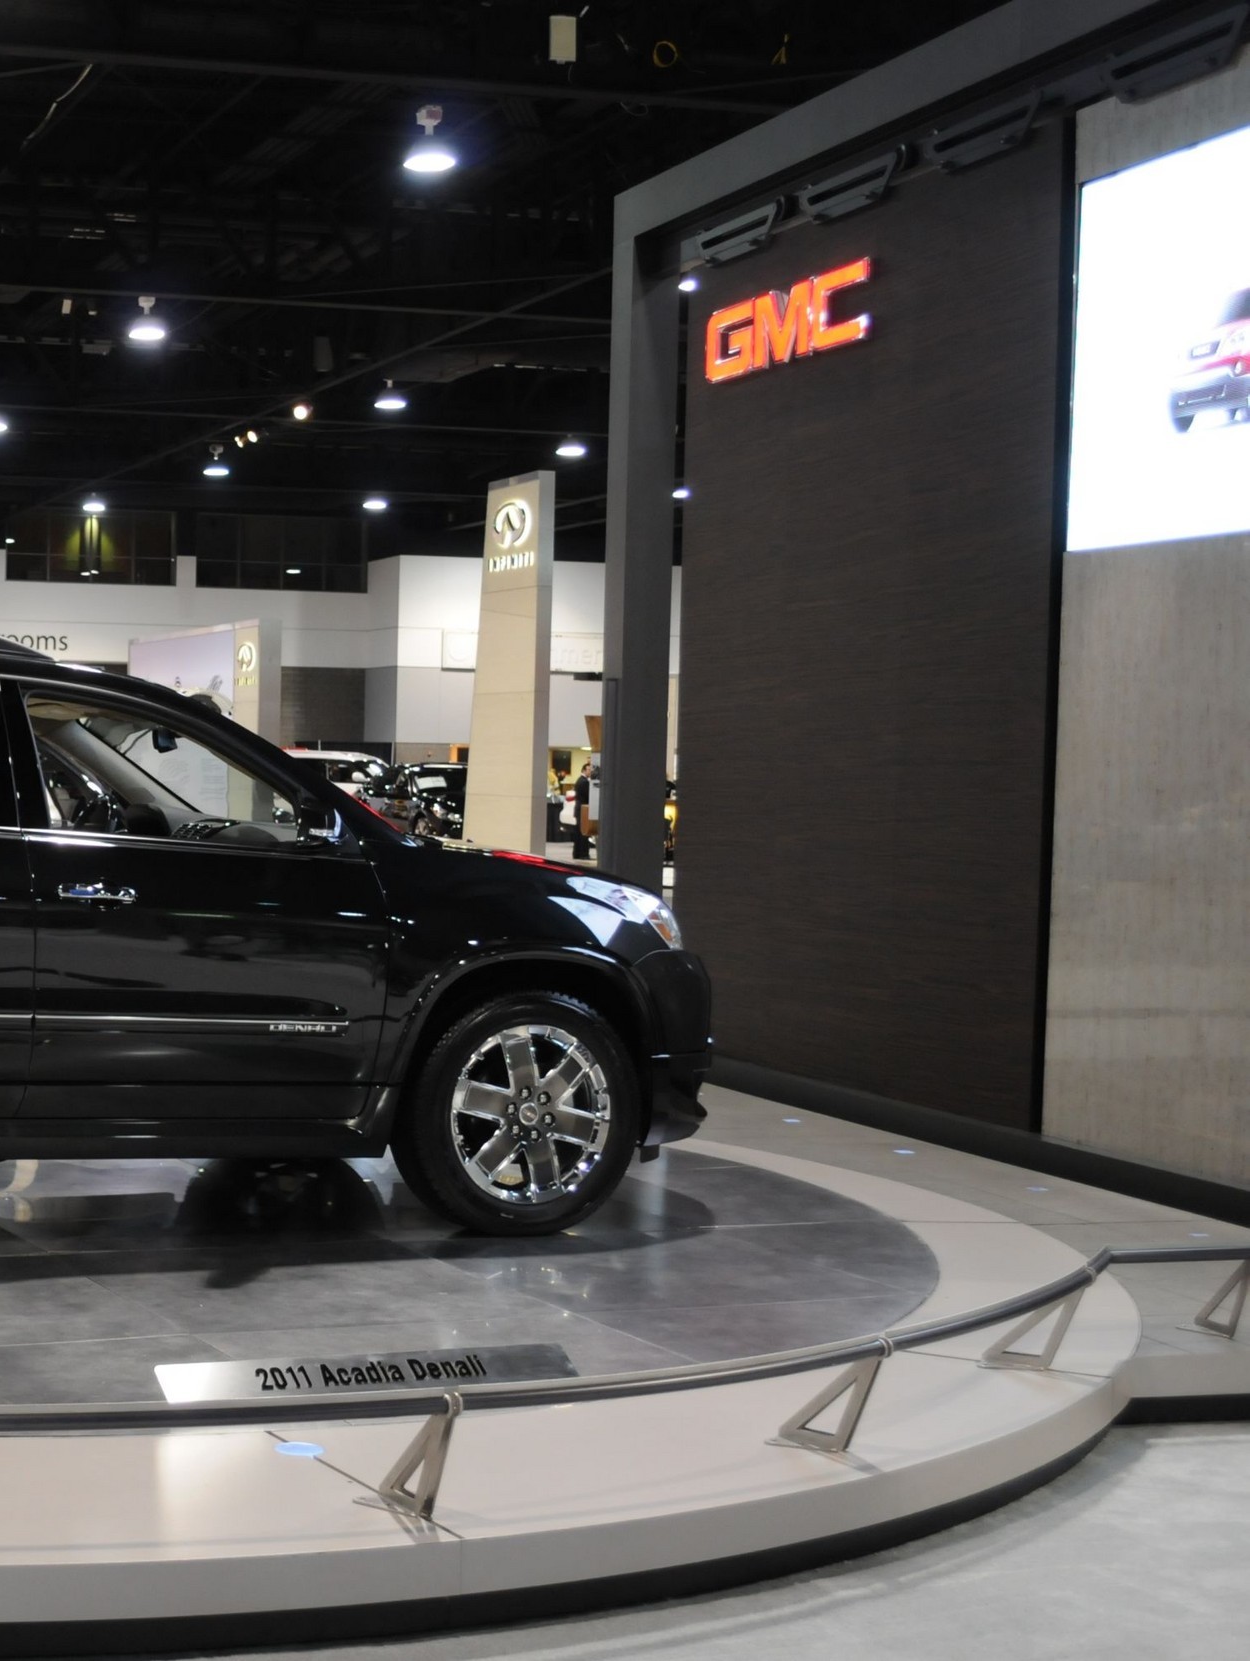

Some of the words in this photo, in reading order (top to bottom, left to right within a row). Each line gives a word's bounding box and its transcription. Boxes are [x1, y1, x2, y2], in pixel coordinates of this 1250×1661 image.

[705, 257, 870, 384] GMC
[0, 634, 68, 651] oms
[255, 1365, 312, 1391] 2011
[320, 1361, 405, 1387] Acadia
[406, 1355, 487, 1381] Denali
